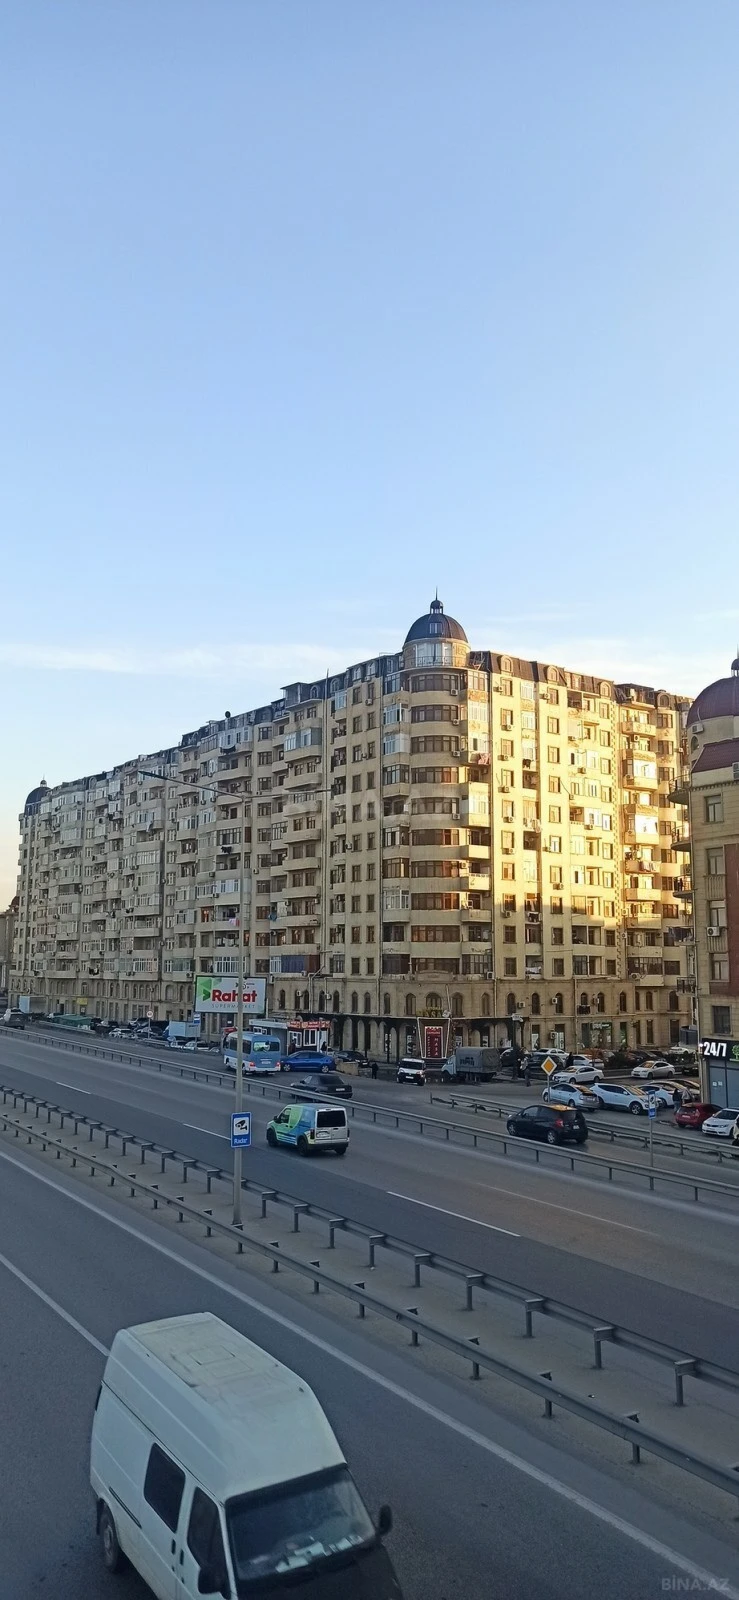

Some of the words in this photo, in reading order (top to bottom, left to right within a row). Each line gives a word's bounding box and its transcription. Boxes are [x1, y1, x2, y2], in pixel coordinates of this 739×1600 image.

[212, 989, 257, 1002] Rahat
[703, 1041, 727, 1057] 24/7
[233, 1137, 248, 1145] Radar
